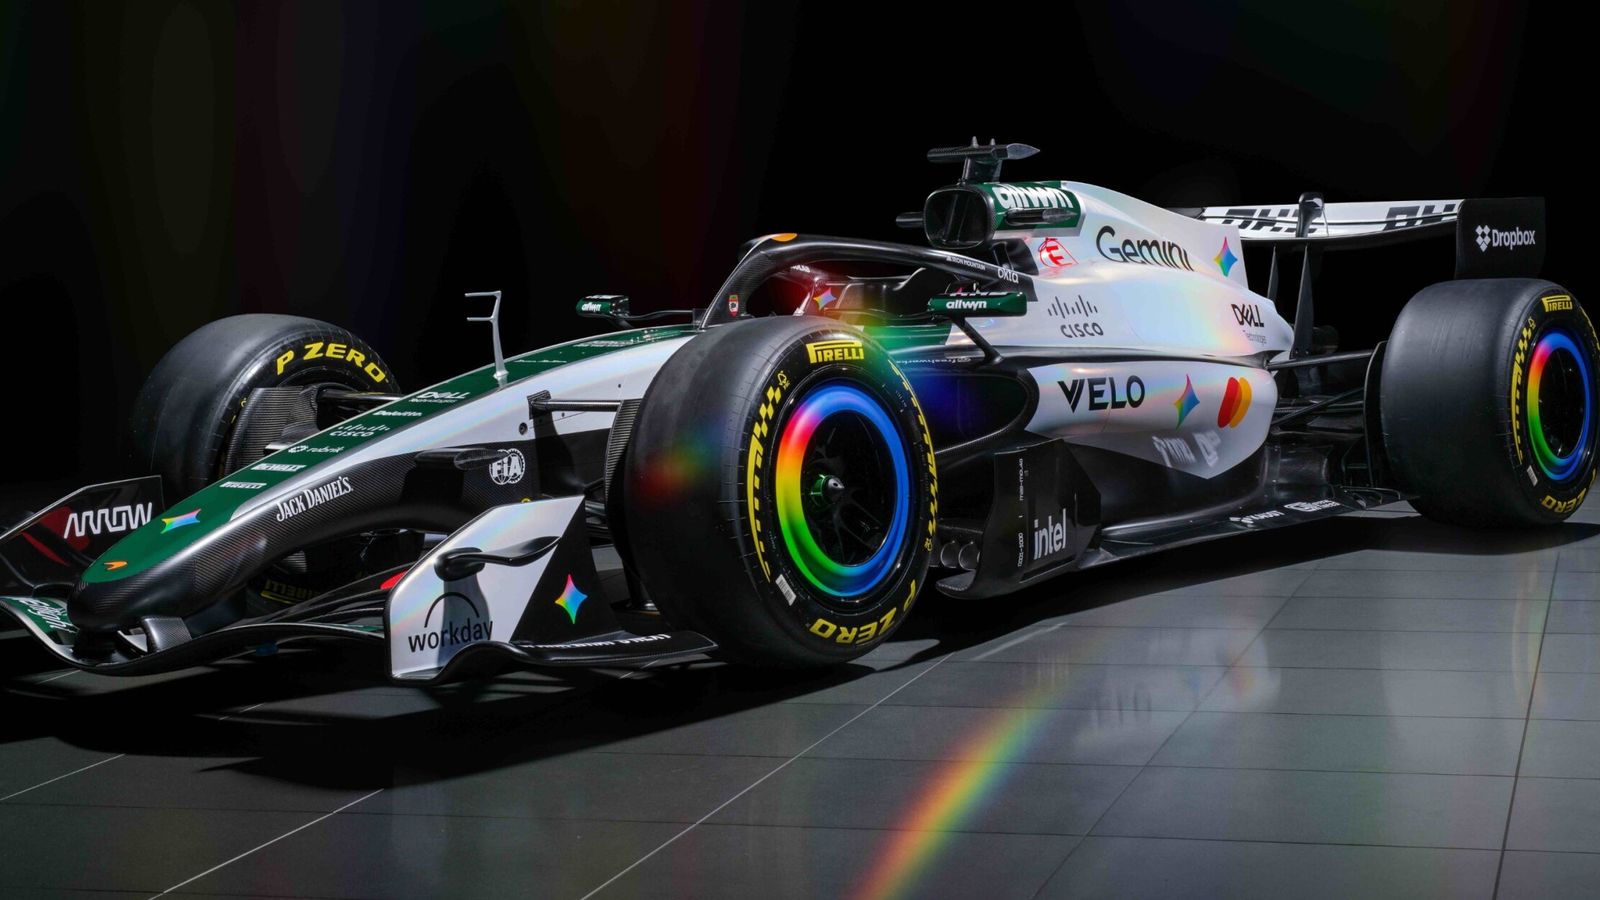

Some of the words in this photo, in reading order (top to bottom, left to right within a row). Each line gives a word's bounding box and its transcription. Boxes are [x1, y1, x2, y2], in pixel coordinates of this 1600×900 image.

[992, 184, 1074, 209] allwyn
[1096, 226, 1195, 271] Gemini
[1492, 227, 1535, 250] Dropbox
[946, 300, 987, 311] allwyn
[1231, 303, 1264, 328] DELL
[1541, 293, 1573, 313] PIRELLI
[275, 349, 296, 376] P
[303, 341, 388, 383] ZERO
[806, 340, 864, 364] PIRELLI
[1057, 375, 1145, 414] VELO
[492, 455, 522, 477] FIA
[63, 501, 153, 539] ARROW
[276, 496, 305, 522] JACK
[1033, 507, 1067, 560] intel
[408, 620, 493, 653] workday
[809, 607, 897, 646] ZERO
